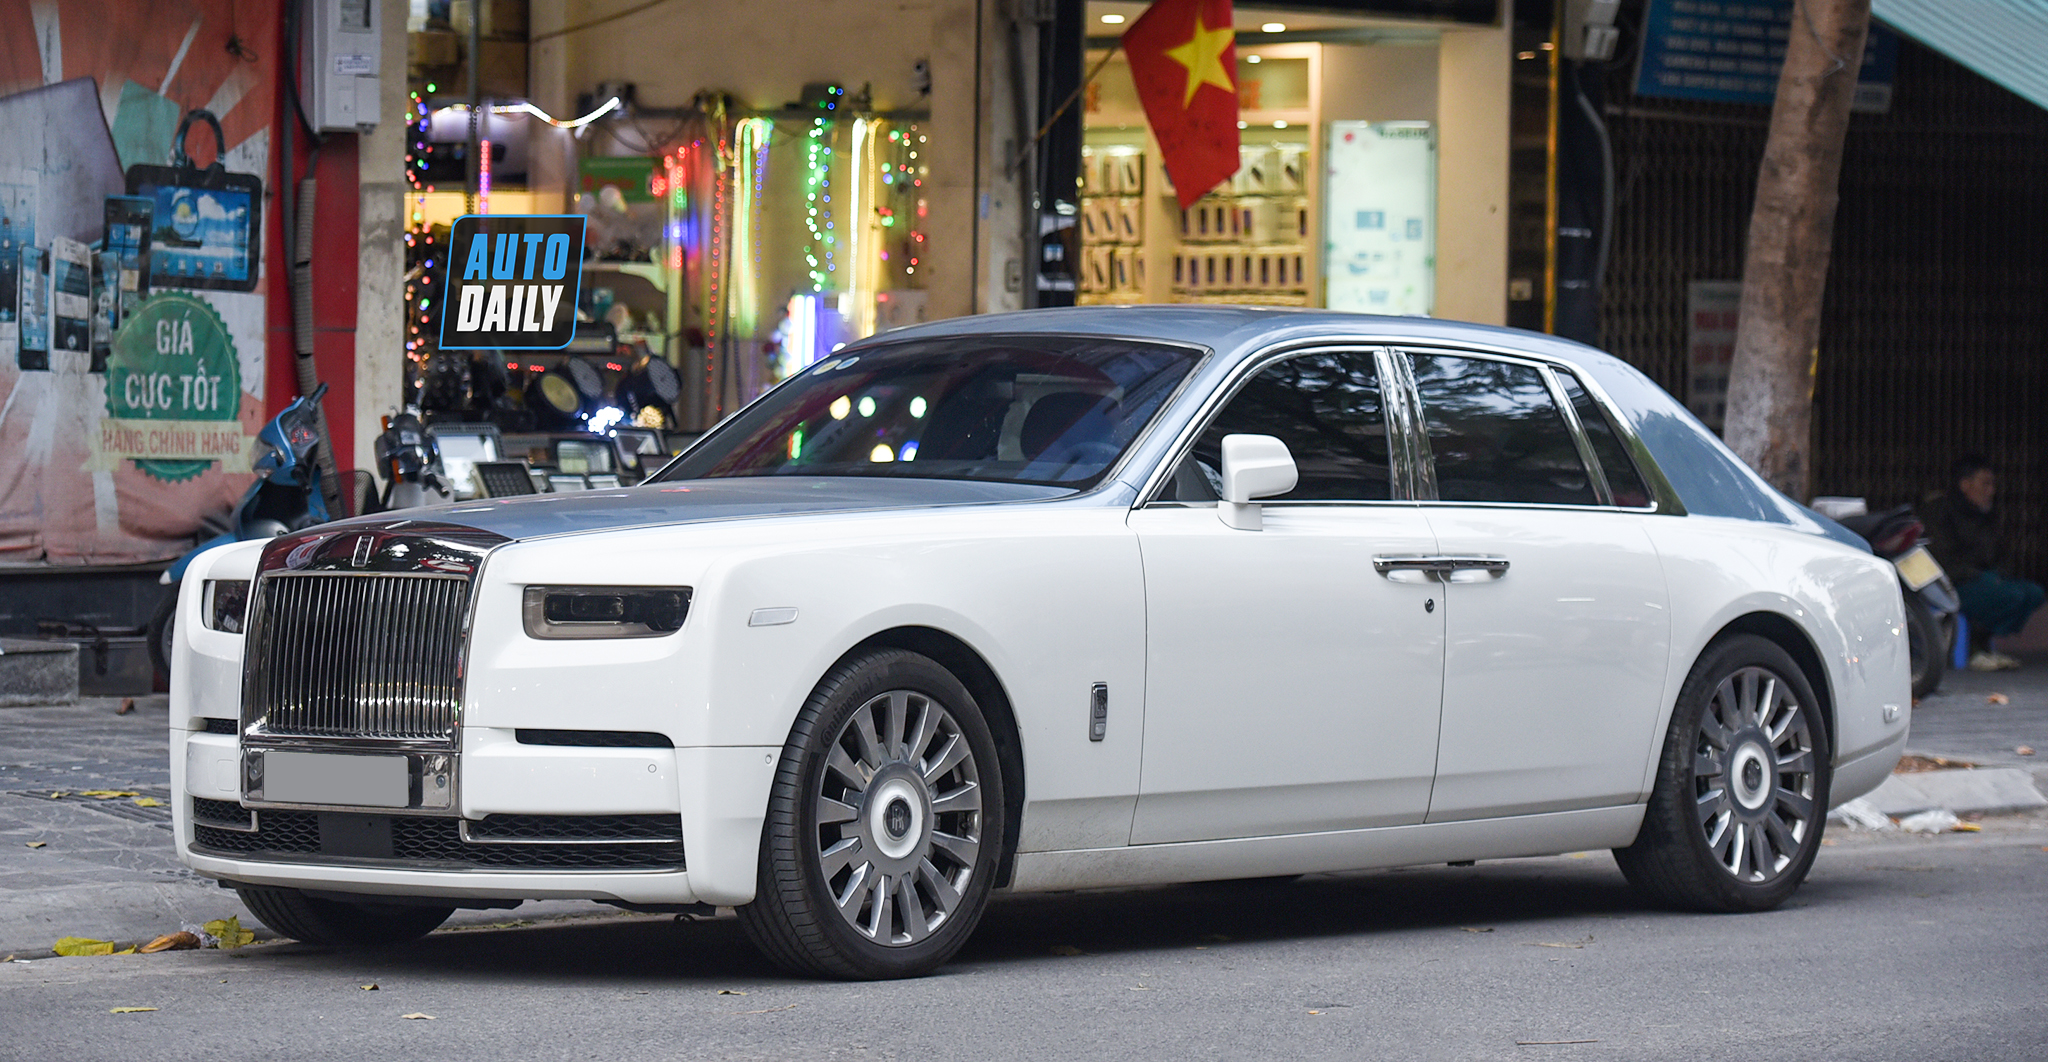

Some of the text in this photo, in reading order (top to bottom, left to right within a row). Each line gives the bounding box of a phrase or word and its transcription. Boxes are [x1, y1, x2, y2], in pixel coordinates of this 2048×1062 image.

[156, 309, 194, 356] GIÁ
[124, 358, 222, 418] CỰC TỐT
[820, 676, 873, 748] Continental
